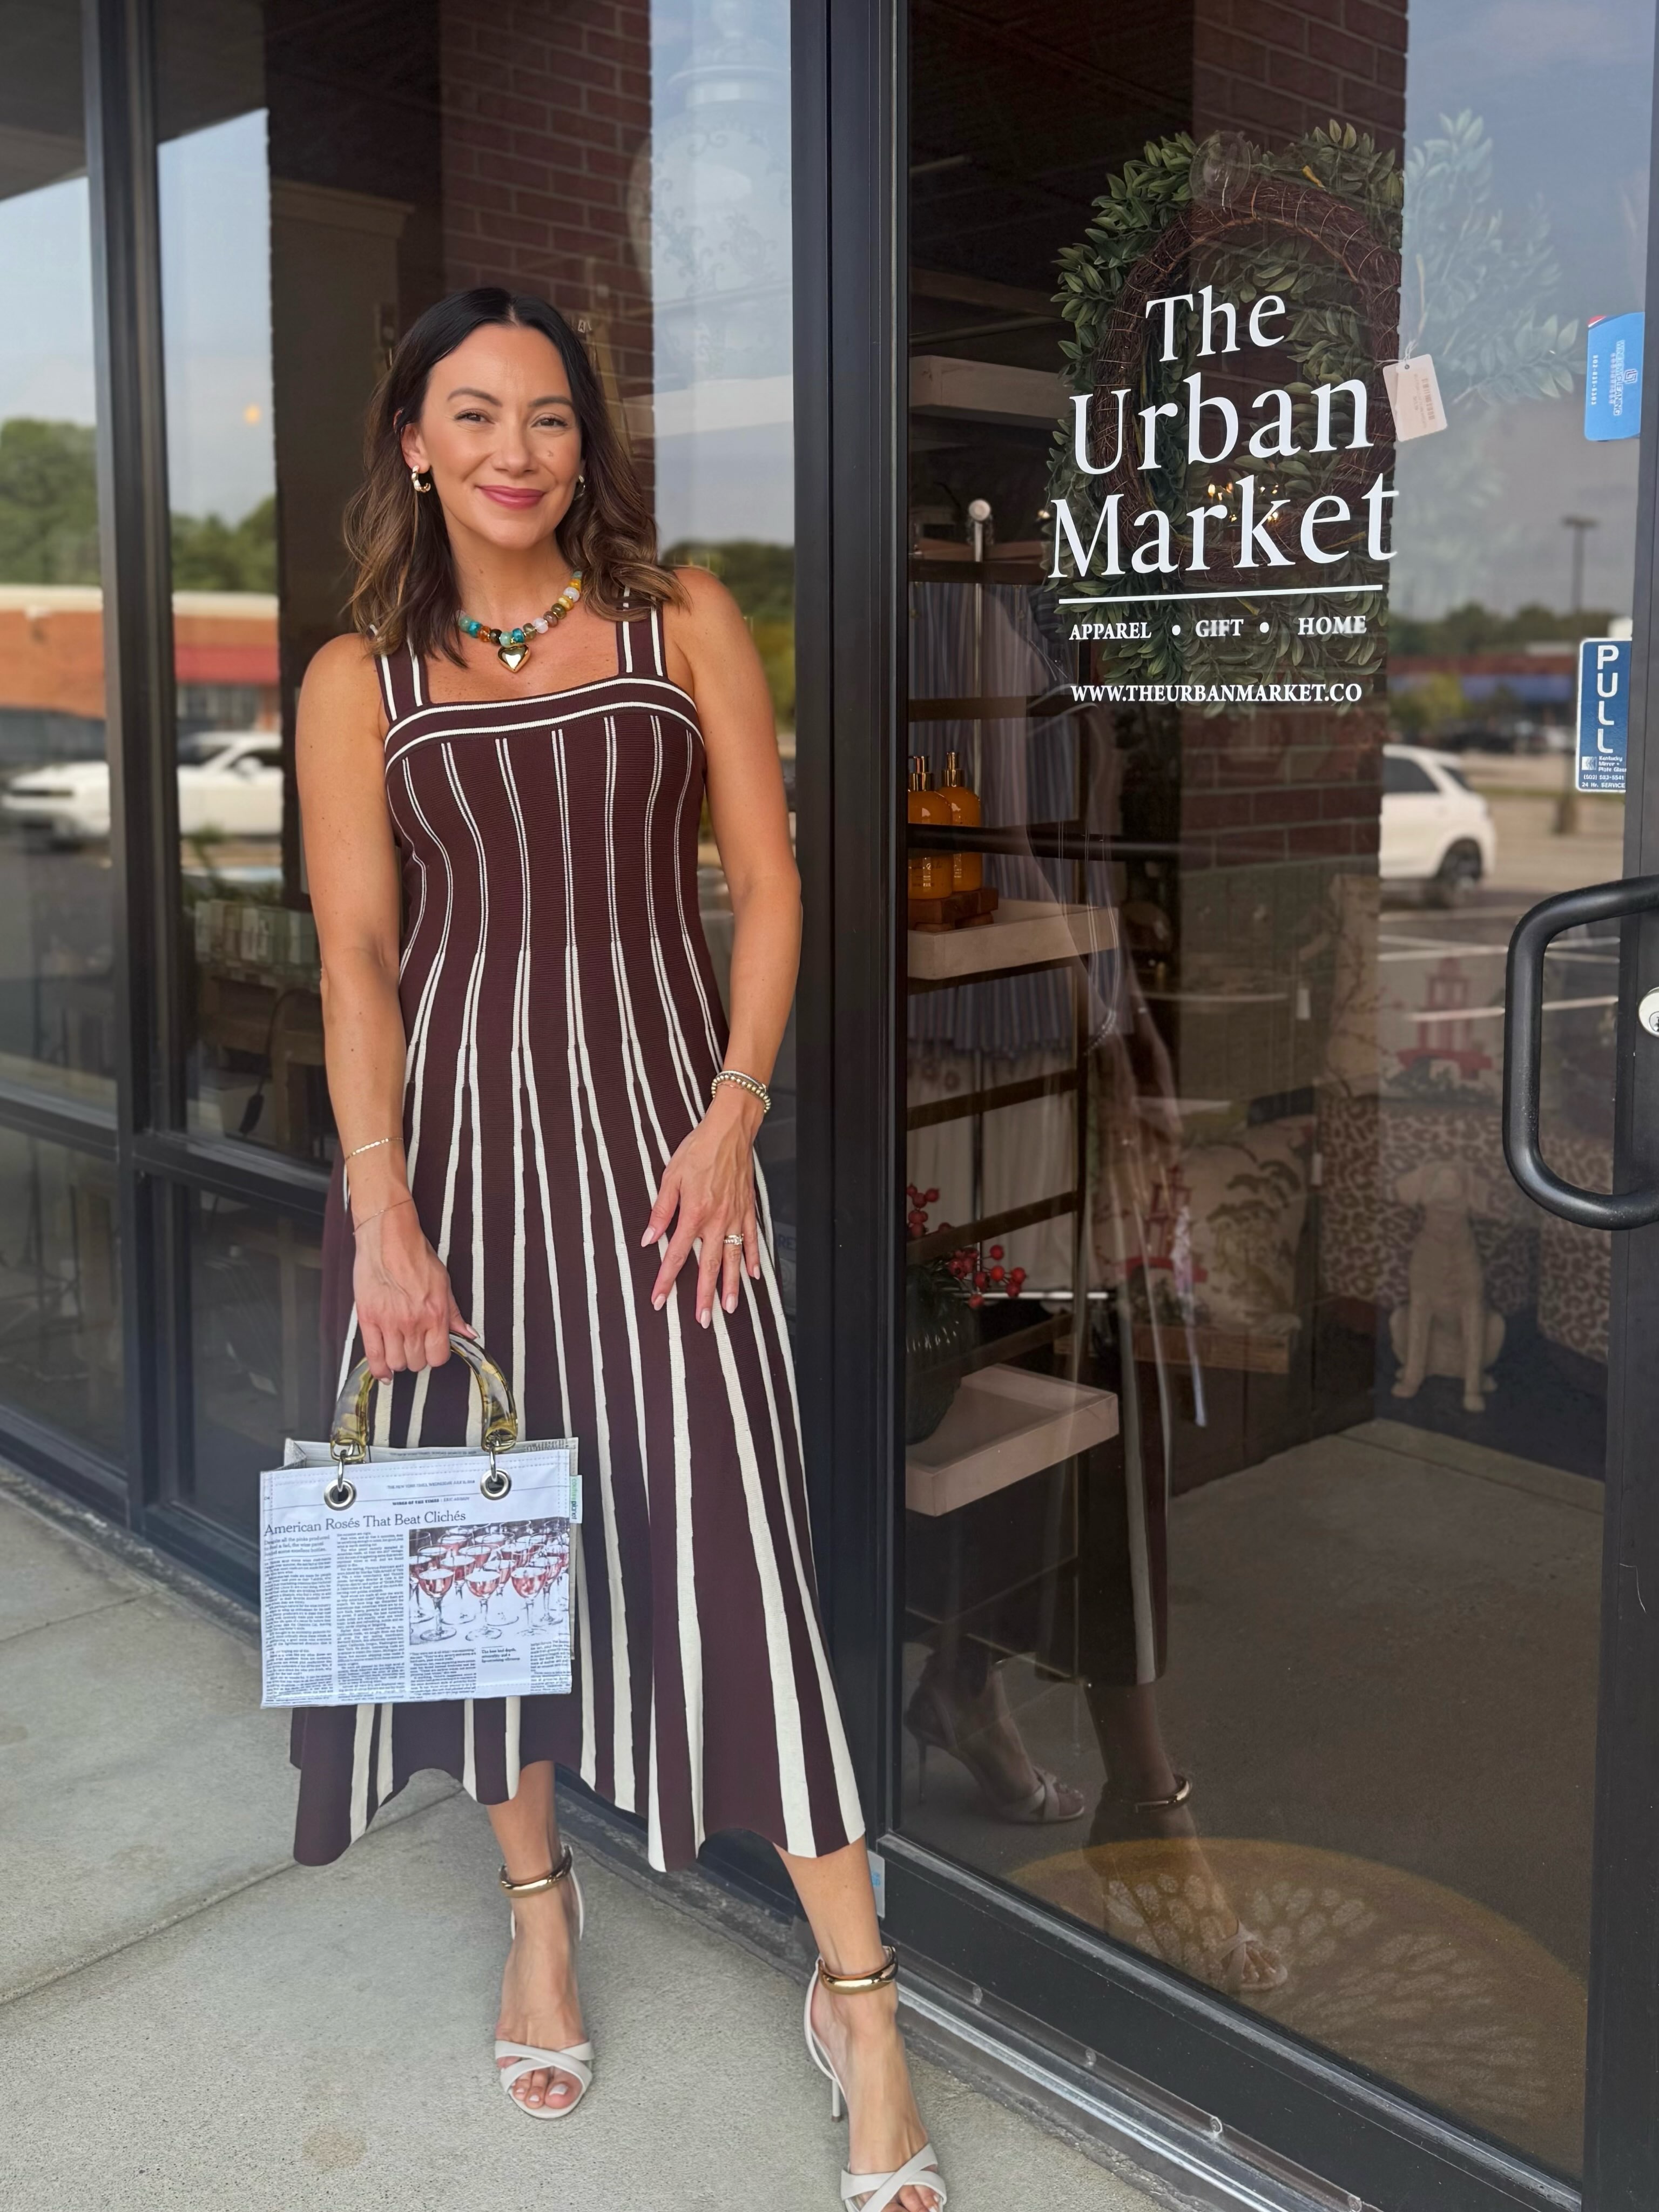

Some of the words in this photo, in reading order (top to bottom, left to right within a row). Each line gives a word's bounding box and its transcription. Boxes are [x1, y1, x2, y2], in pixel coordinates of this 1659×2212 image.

[1145, 285, 1285, 362] The
[1069, 372, 1374, 475] Urban
[1048, 473, 1399, 579] Market
[1069, 622, 1152, 641] APPAREL
[1195, 619, 1244, 638] GIFT
[1297, 615, 1367, 636] HOME
[1070, 683, 1363, 703] WWW.THEURBANMARKET.CO
[1597, 645, 1619, 754] PULL
[264, 1522, 322, 1536] American
[326, 1518, 360, 1530] Rosés
[363, 1515, 391, 1528] That
[395, 1514, 421, 1526] Beat
[424, 1510, 467, 1523] Clichés
